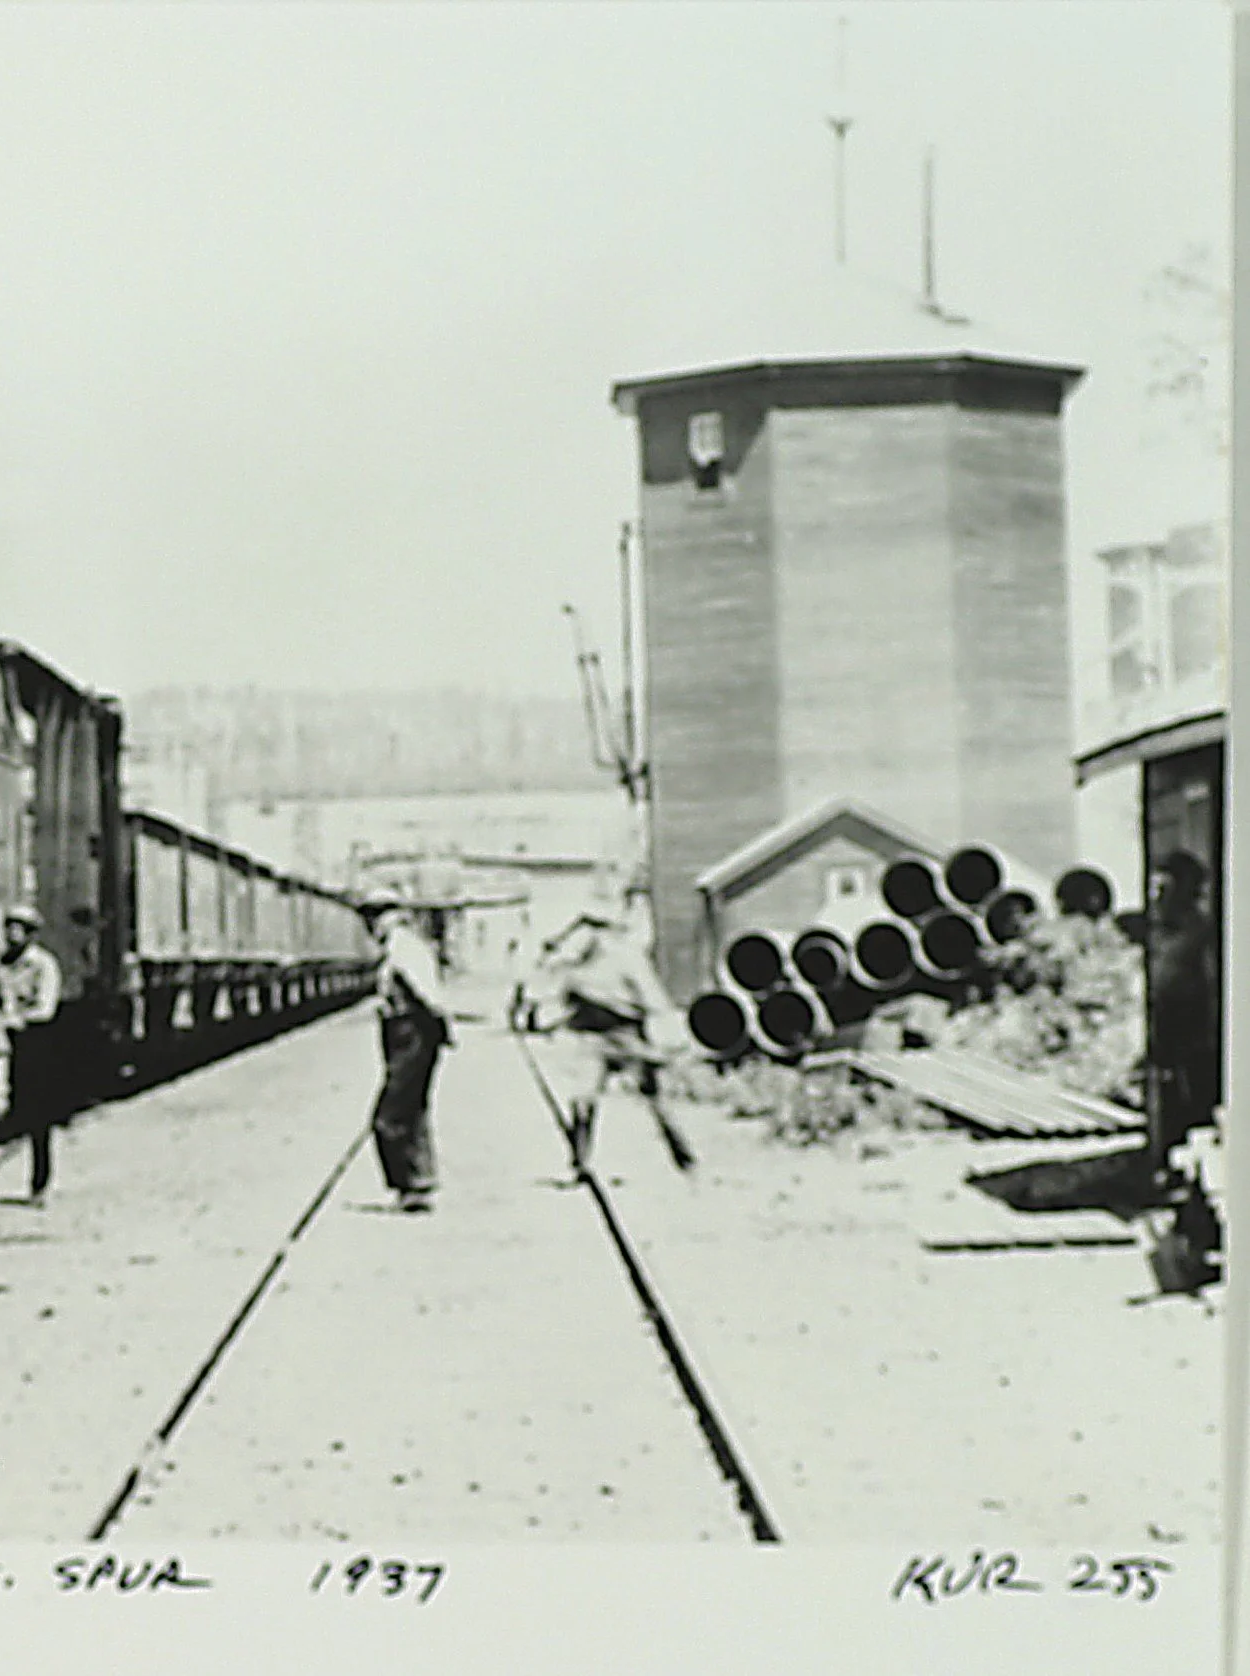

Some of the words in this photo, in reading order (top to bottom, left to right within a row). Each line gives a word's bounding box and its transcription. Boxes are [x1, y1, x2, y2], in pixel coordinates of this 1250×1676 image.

[53, 1554, 212, 1592] SPUR
[309, 1554, 446, 1603] 1937
[1068, 1555, 1174, 1601] 255
